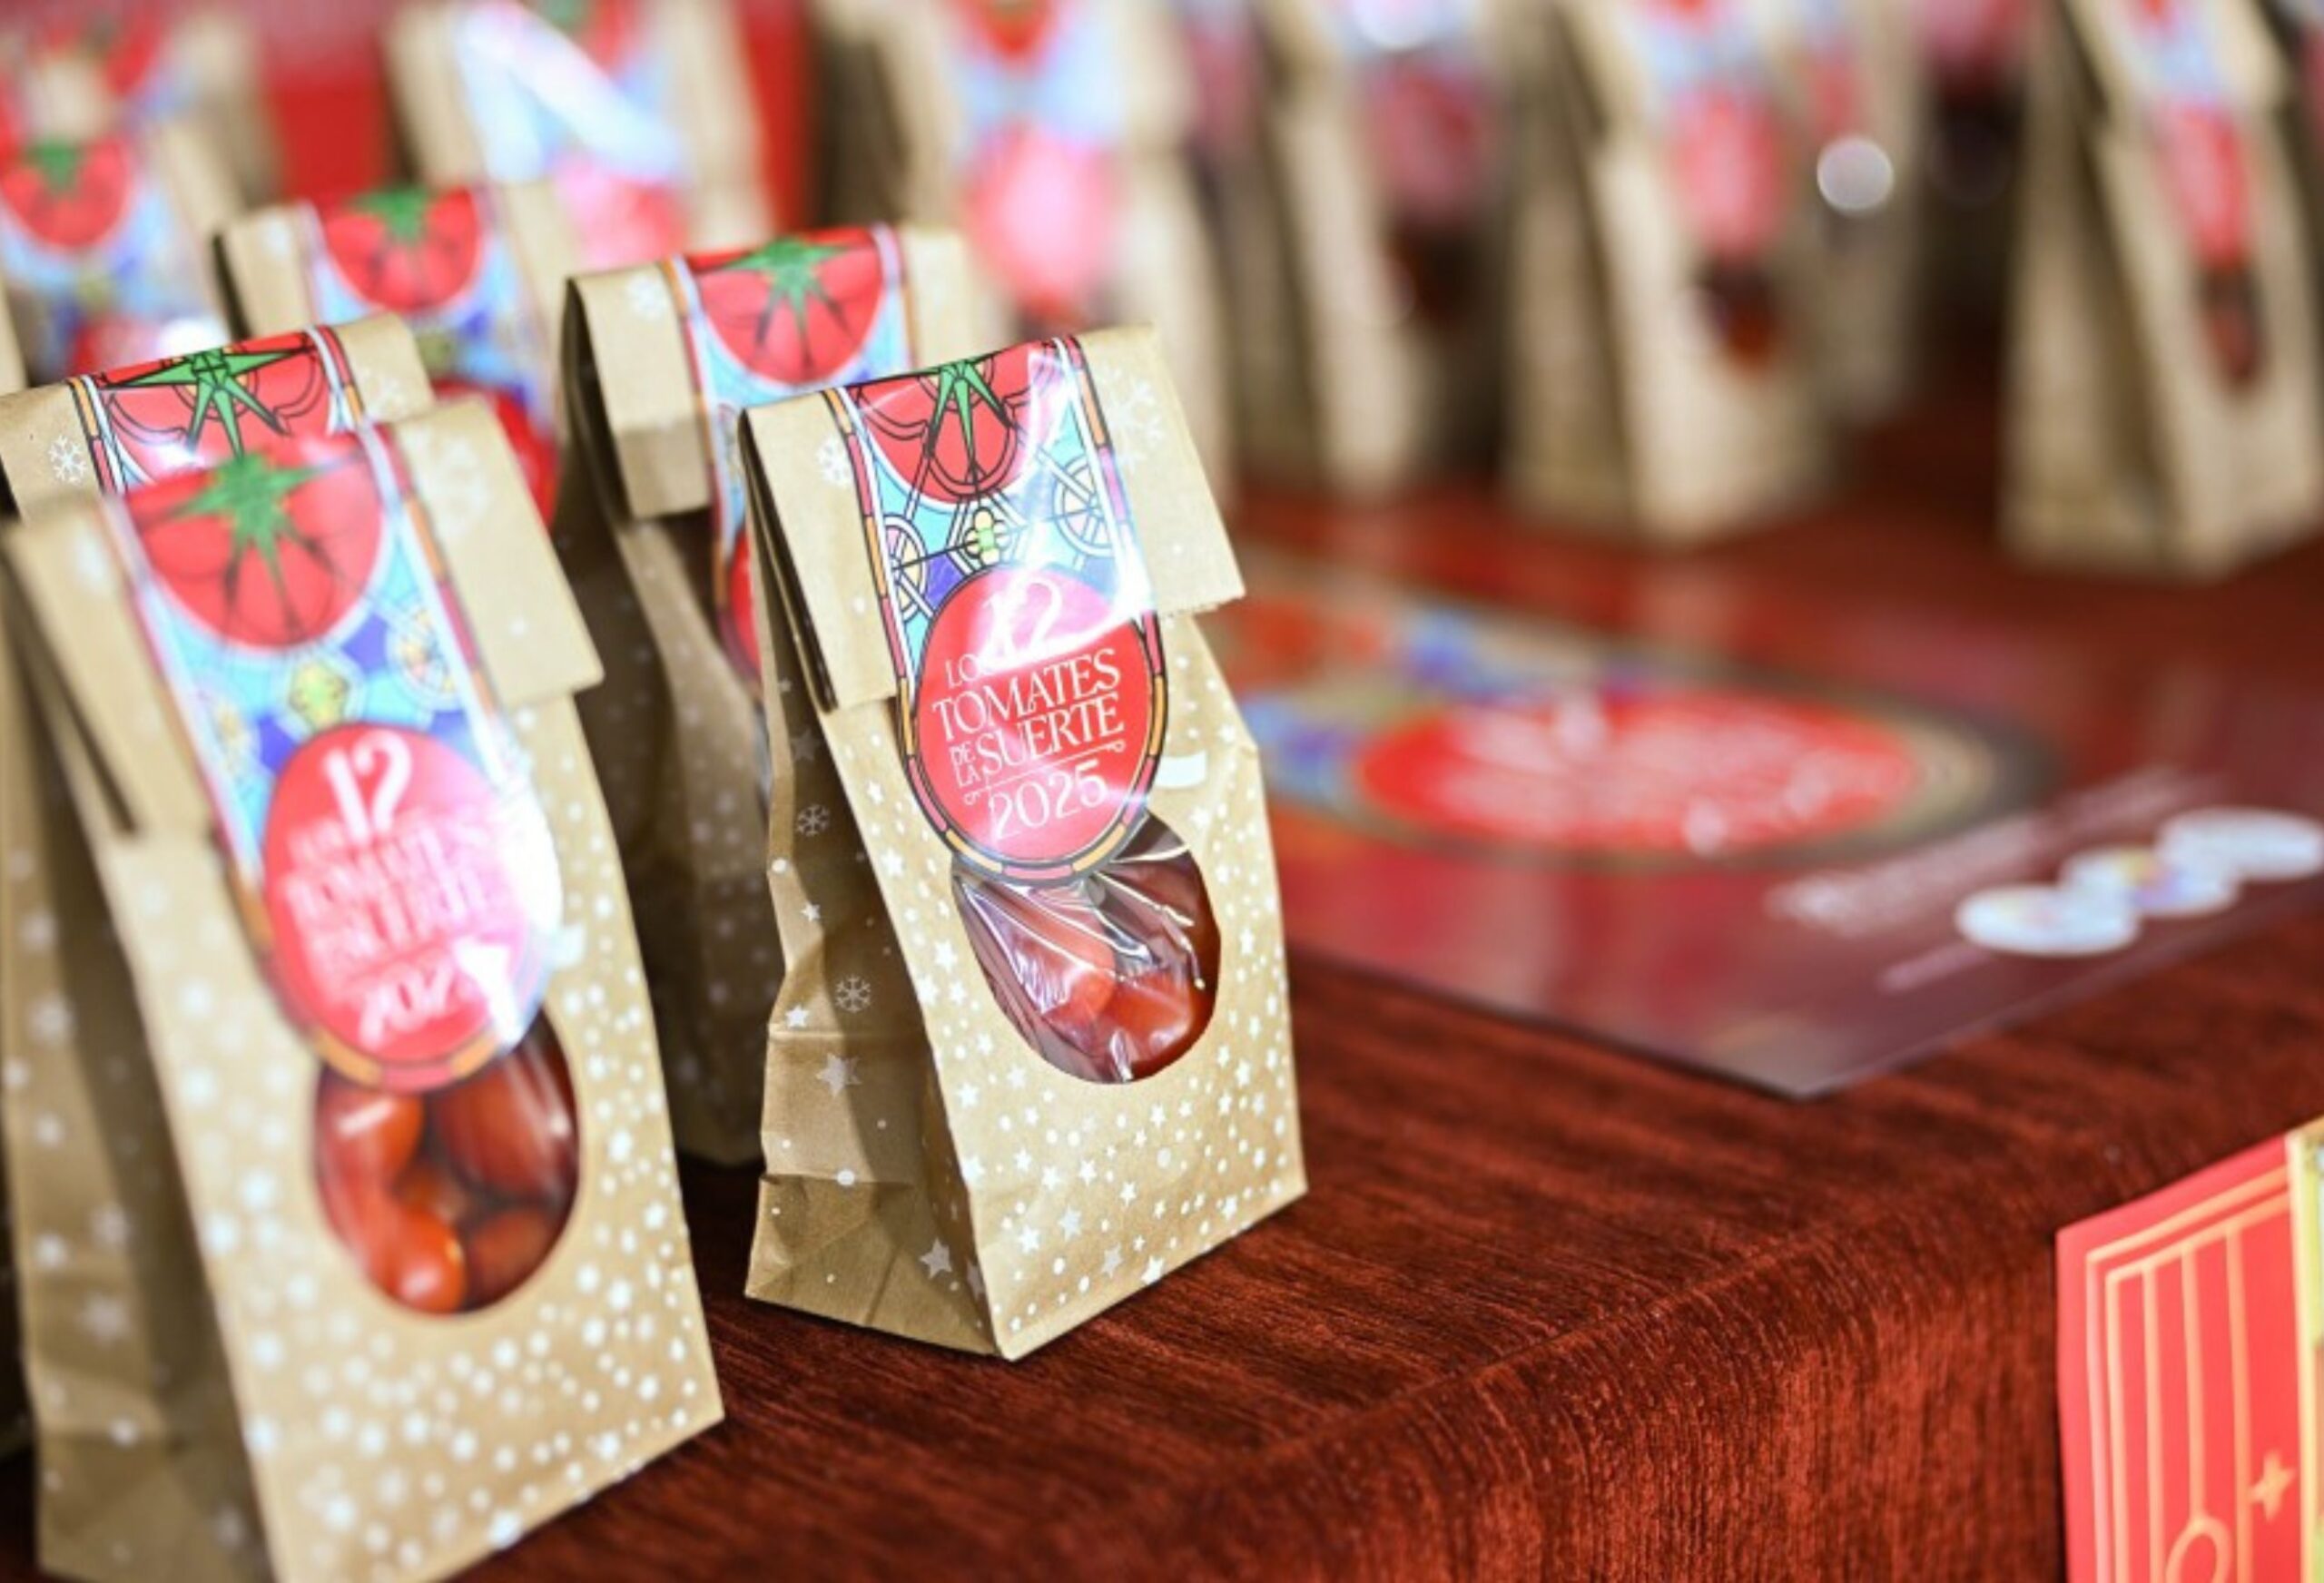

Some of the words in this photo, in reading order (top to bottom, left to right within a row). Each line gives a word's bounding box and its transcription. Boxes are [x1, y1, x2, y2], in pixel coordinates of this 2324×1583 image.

[981, 576, 1069, 664] 12
[931, 647, 1122, 742] TOMATES
[945, 651, 988, 688] LO
[949, 741, 977, 766] DE
[975, 691, 1125, 773] SUERTE
[321, 729, 414, 846] 12
[987, 759, 1108, 841] 2025
